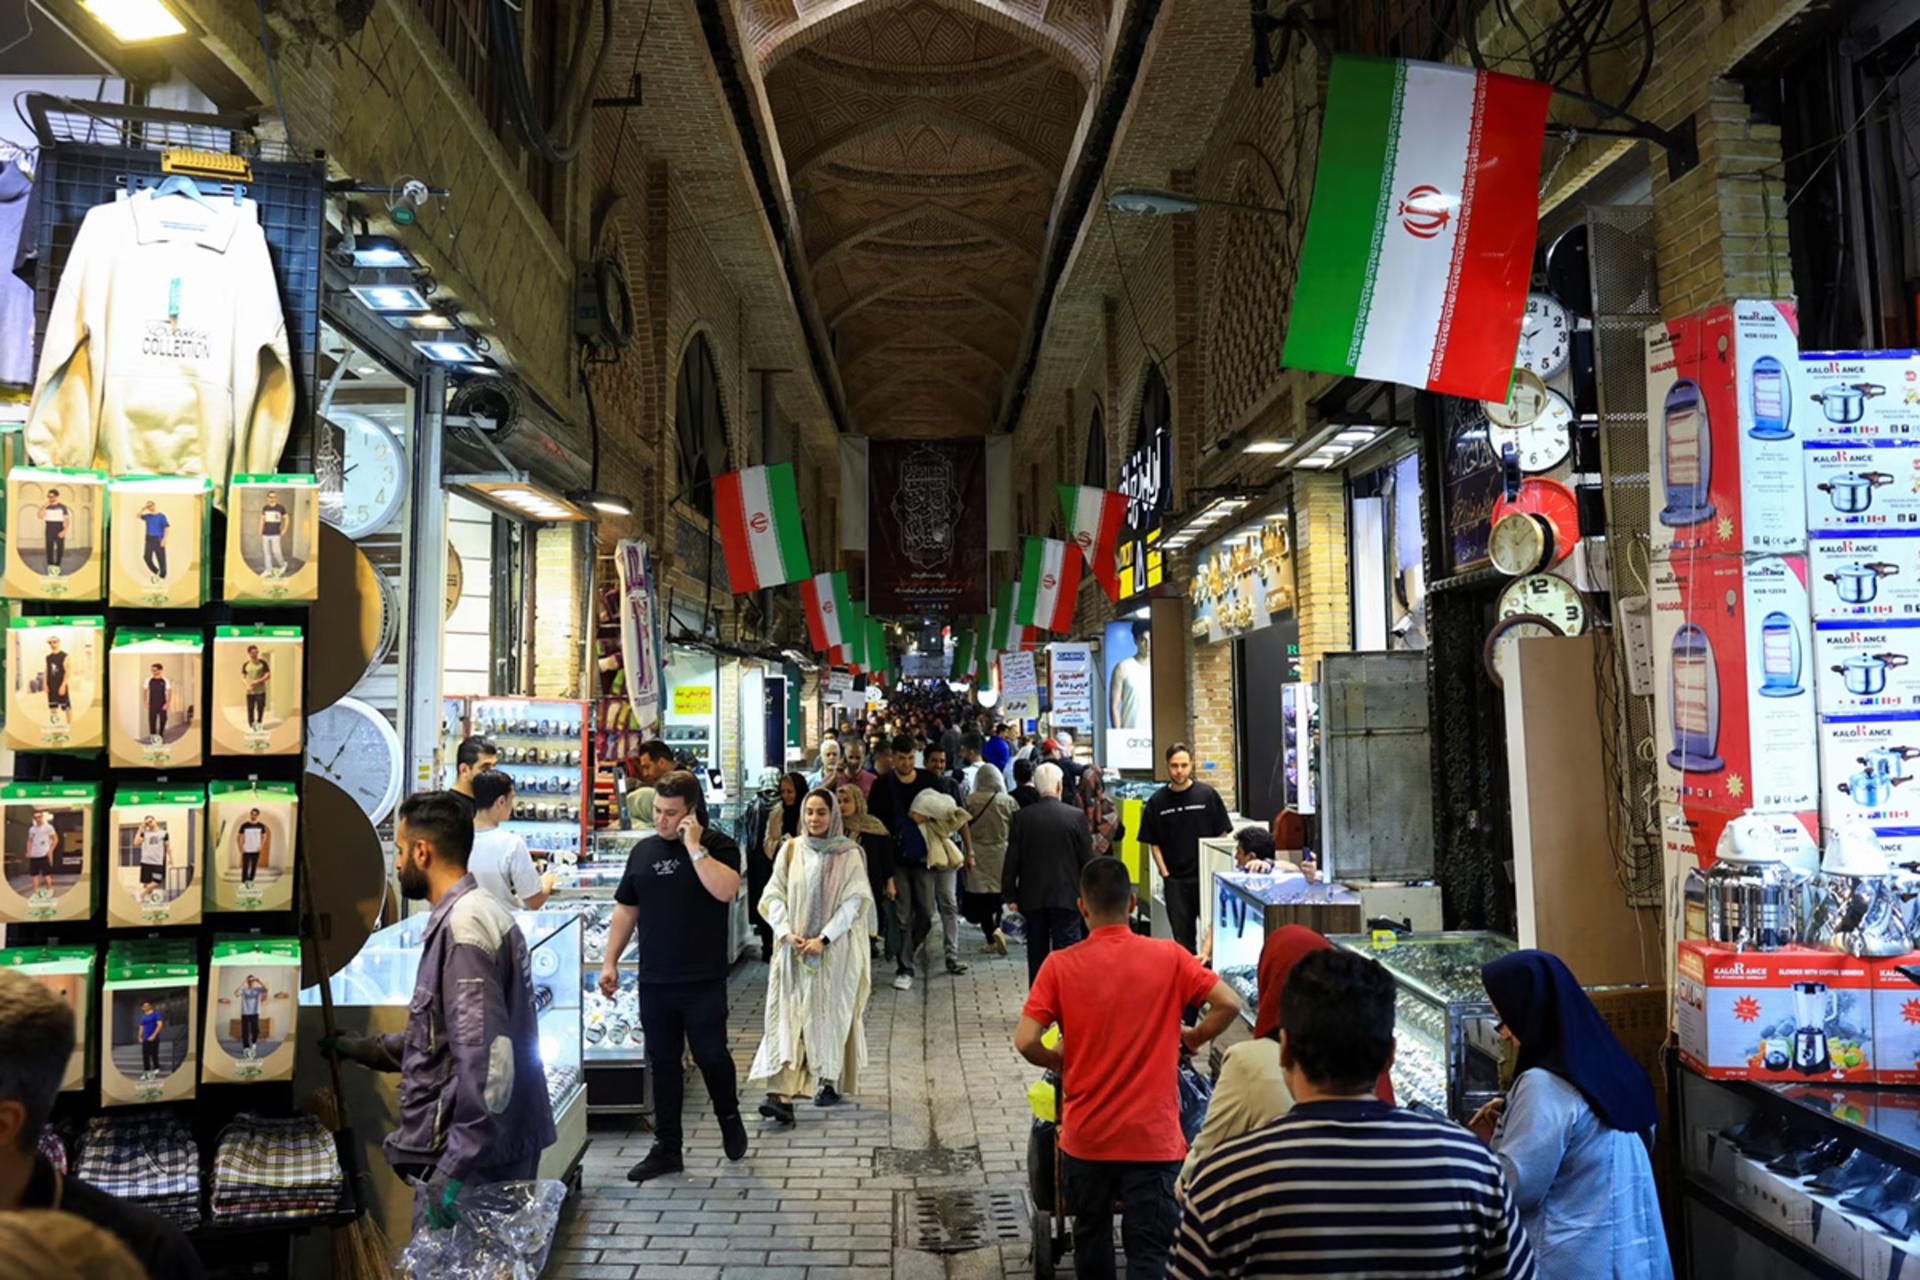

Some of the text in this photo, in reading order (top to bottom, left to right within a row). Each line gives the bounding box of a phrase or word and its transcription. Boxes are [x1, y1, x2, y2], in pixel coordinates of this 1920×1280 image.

[1553, 315, 1562, 328] 2
[1559, 331, 1568, 343] 3
[143, 337, 210, 358] COLLECTION
[1552, 346, 1561, 357] 4
[1541, 357, 1550, 369] 5
[375, 487, 385, 505] 4
[357, 505, 369, 523] 5
[1529, 579, 1549, 594] 12
[1565, 605, 1579, 621] 3
